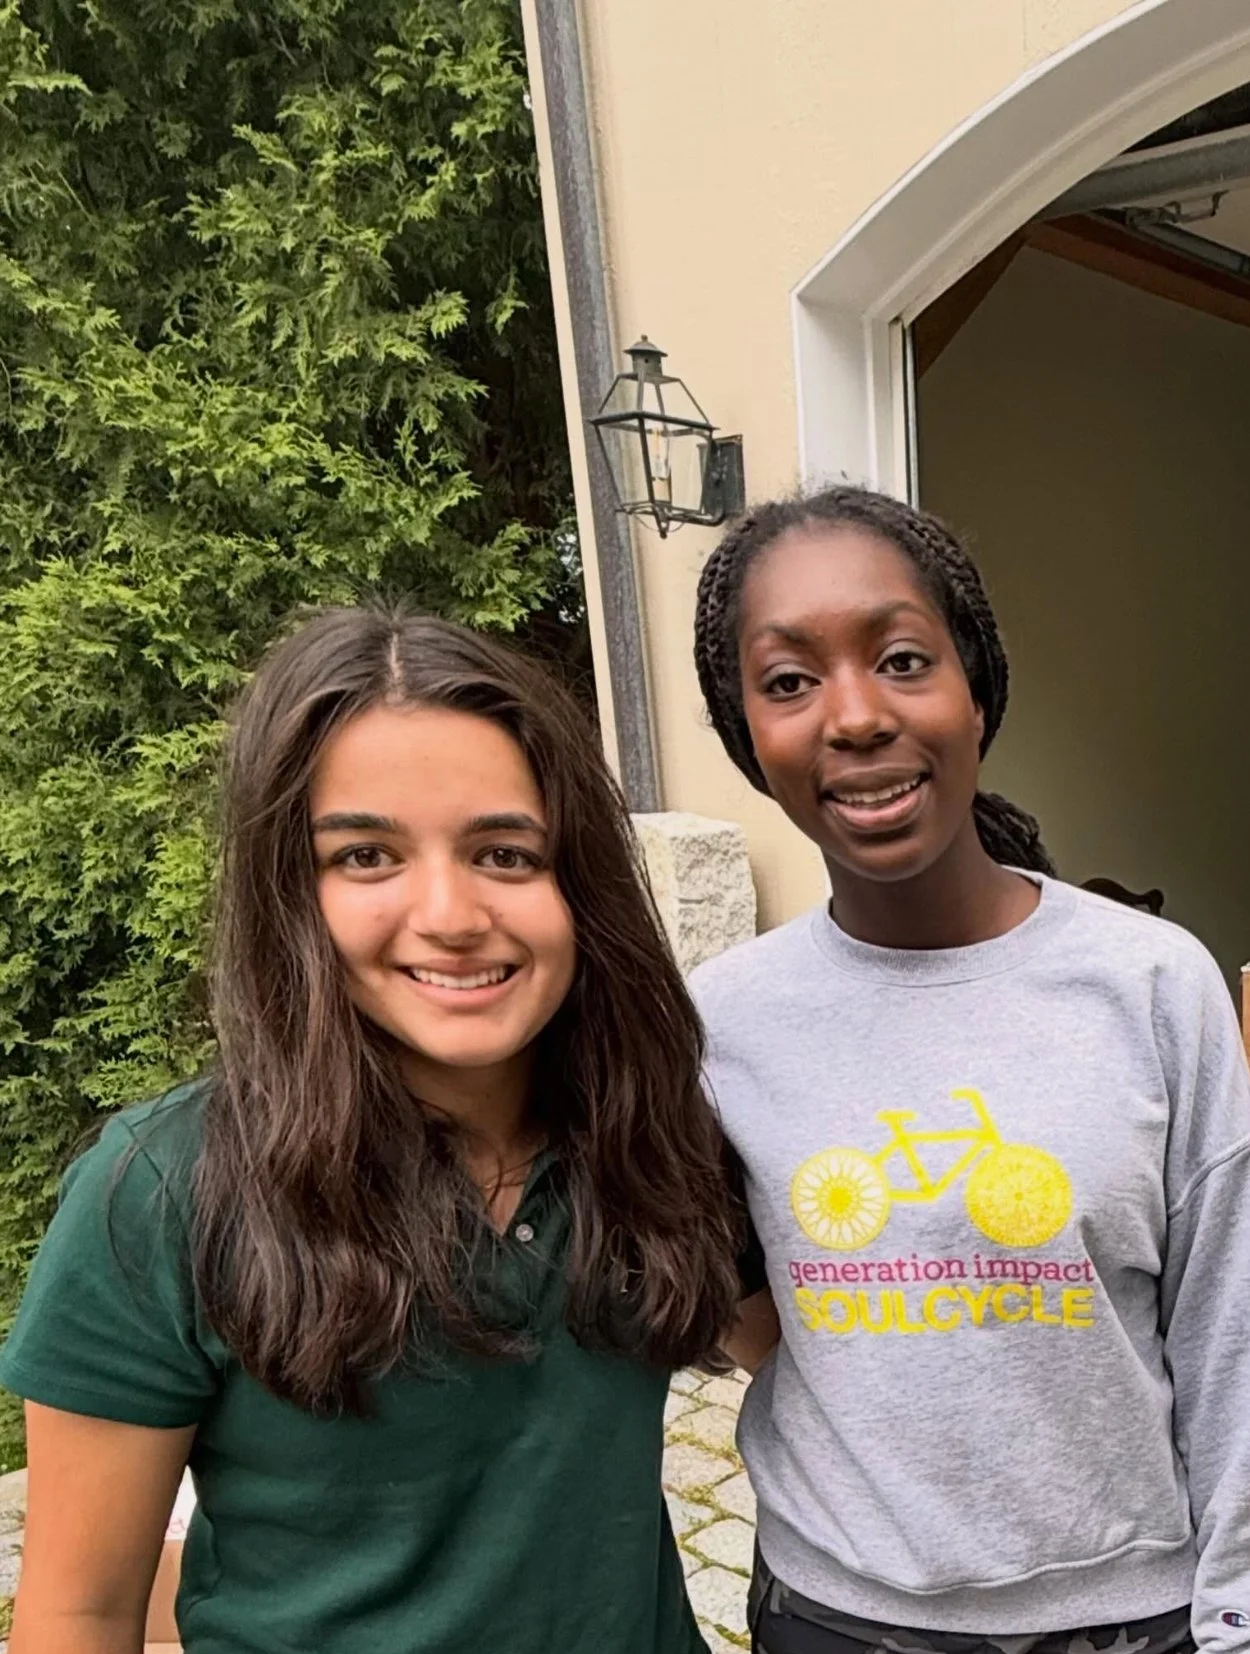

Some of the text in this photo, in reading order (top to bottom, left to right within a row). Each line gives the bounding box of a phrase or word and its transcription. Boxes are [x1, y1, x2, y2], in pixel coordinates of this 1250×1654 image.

[789, 1253, 1095, 1287] generation impact
[795, 1283, 1095, 1335] SOULCYCLE
